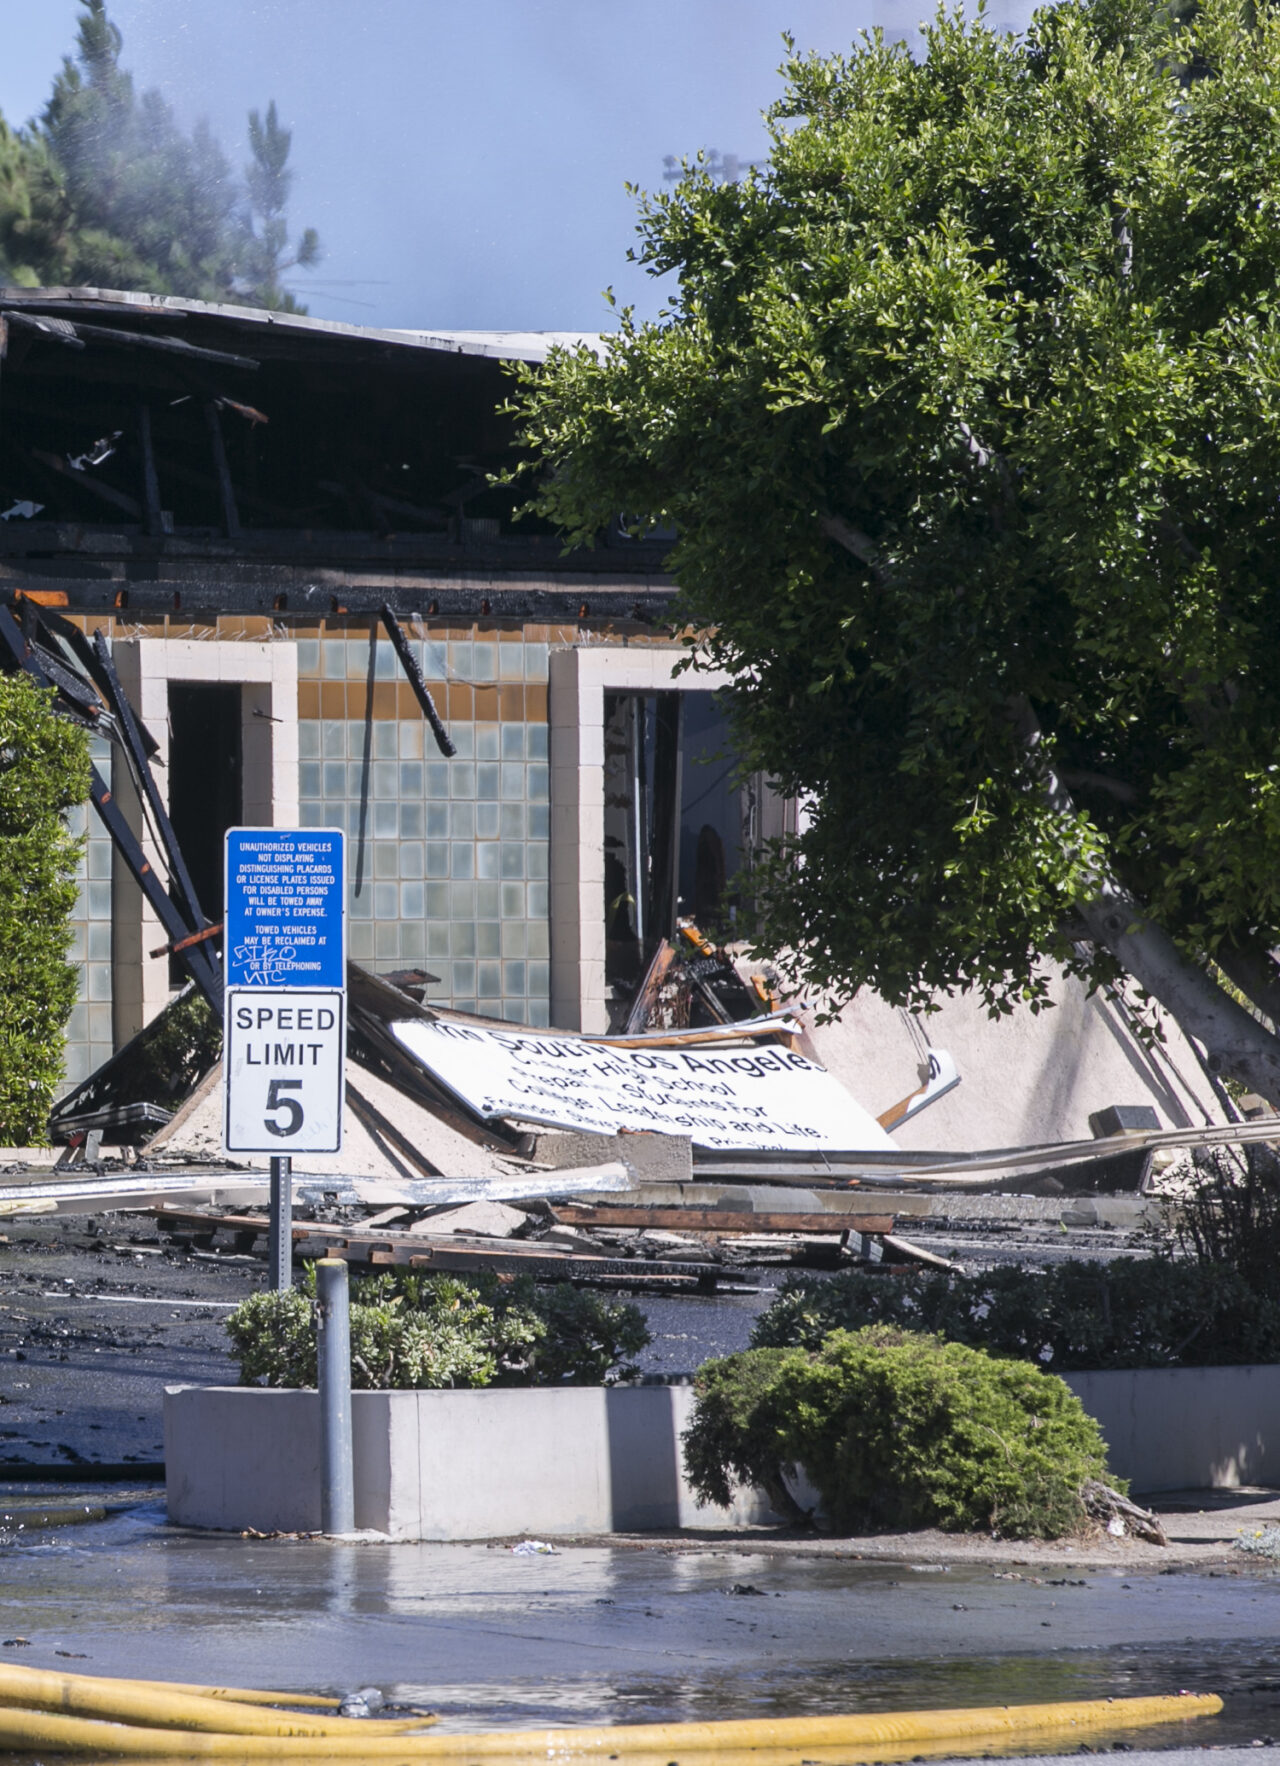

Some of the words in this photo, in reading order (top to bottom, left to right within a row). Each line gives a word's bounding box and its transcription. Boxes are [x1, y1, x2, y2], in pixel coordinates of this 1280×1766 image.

[239, 842, 295, 852] UNAUTHORIZED
[297, 842, 332, 852] VEHICLES
[257, 853, 272, 863] NOT
[274, 853, 314, 863] DISPLAYING
[239, 864, 295, 874] DISTINGUISHING
[296, 864, 333, 874] PLACARDS
[236, 875, 247, 885] OR
[249, 875, 279, 885] LICENSE
[281, 875, 308, 885] PLATES
[309, 875, 336, 885] ISSUED
[242, 886, 257, 895] FOR
[259, 886, 294, 895] DISABLED
[296, 886, 329, 895] PERSONS
[248, 896, 265, 906] WILL
[267, 896, 278, 906] BE
[280, 896, 304, 906] TOWED
[305, 896, 324, 906] AWAY
[244, 907, 253, 917] AT
[255, 907, 291, 917] OWNER'S
[292, 907, 328, 917] EXPENSE.
[255, 925, 280, 935] TOWED
[281, 925, 318, 935] VEHICLES
[243, 936, 259, 946] MAY
[261, 936, 272, 946] BE
[274, 936, 316, 946] RECLAIMED
[317, 936, 327, 946] AT
[250, 961, 260, 971] OR
[262, 961, 272, 971] BY
[274, 961, 322, 971] TELEPHONING
[236, 1007, 335, 1030] SPEED
[246, 1043, 324, 1066] LIMIT
[652, 1075, 737, 1096] School
[263, 1079, 305, 1138] 5
[729, 1119, 775, 1134] and
